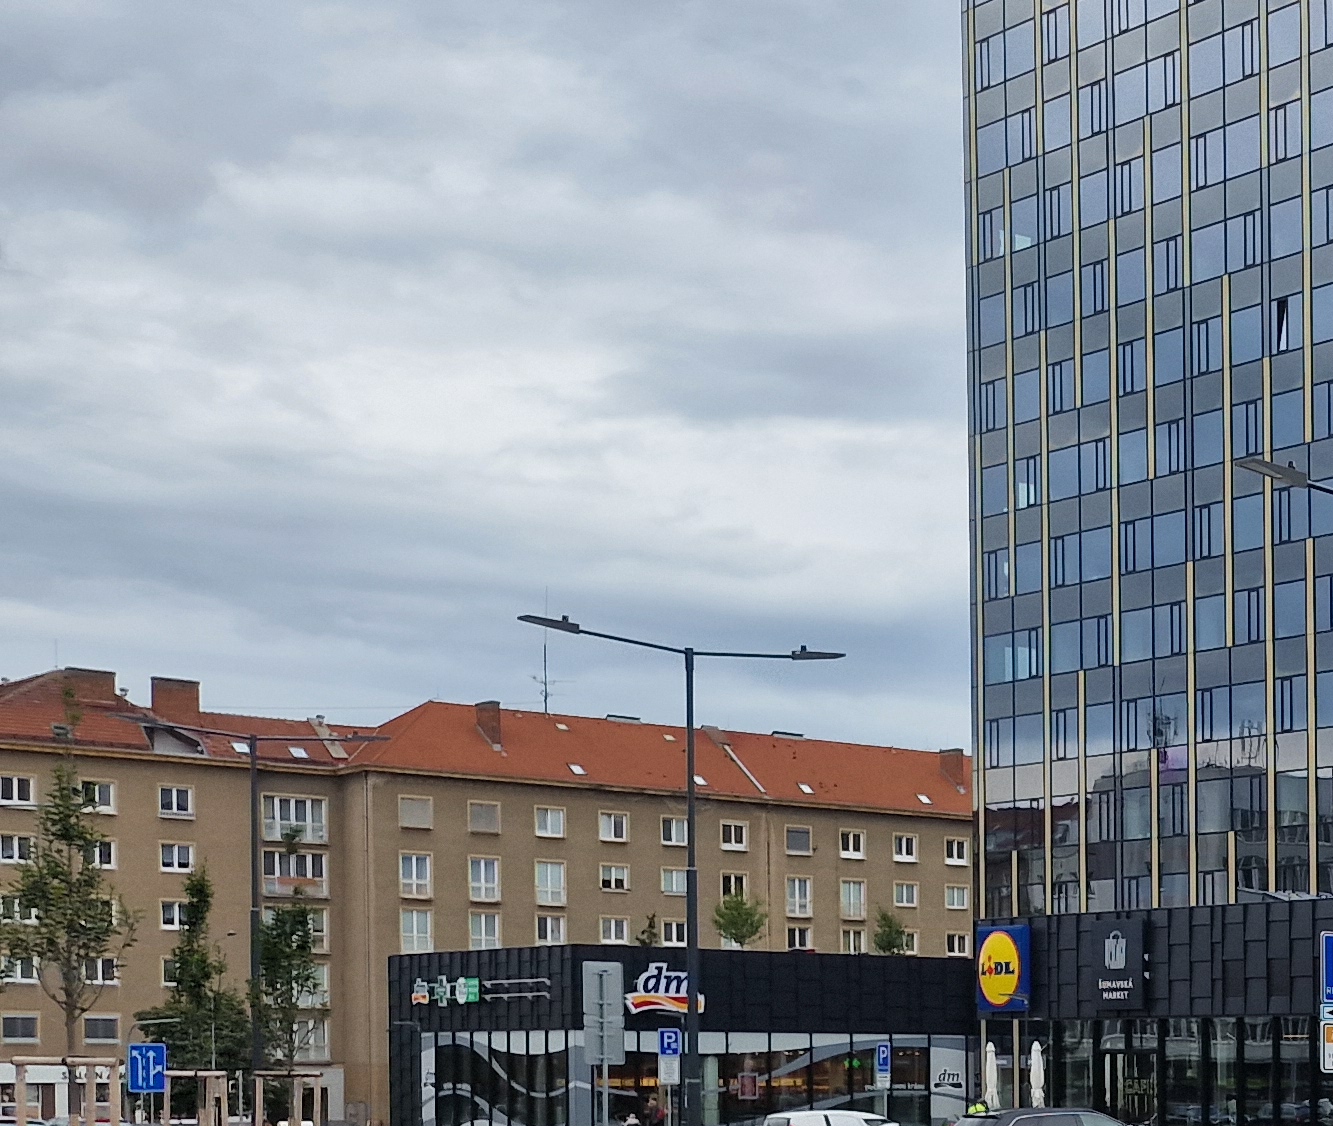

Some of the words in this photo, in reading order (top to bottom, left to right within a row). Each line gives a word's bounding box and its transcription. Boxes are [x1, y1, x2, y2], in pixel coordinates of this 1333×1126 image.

[663, 1032, 676, 1049] P
[879, 1046, 888, 1066] P
[937, 1068, 960, 1083] dm
